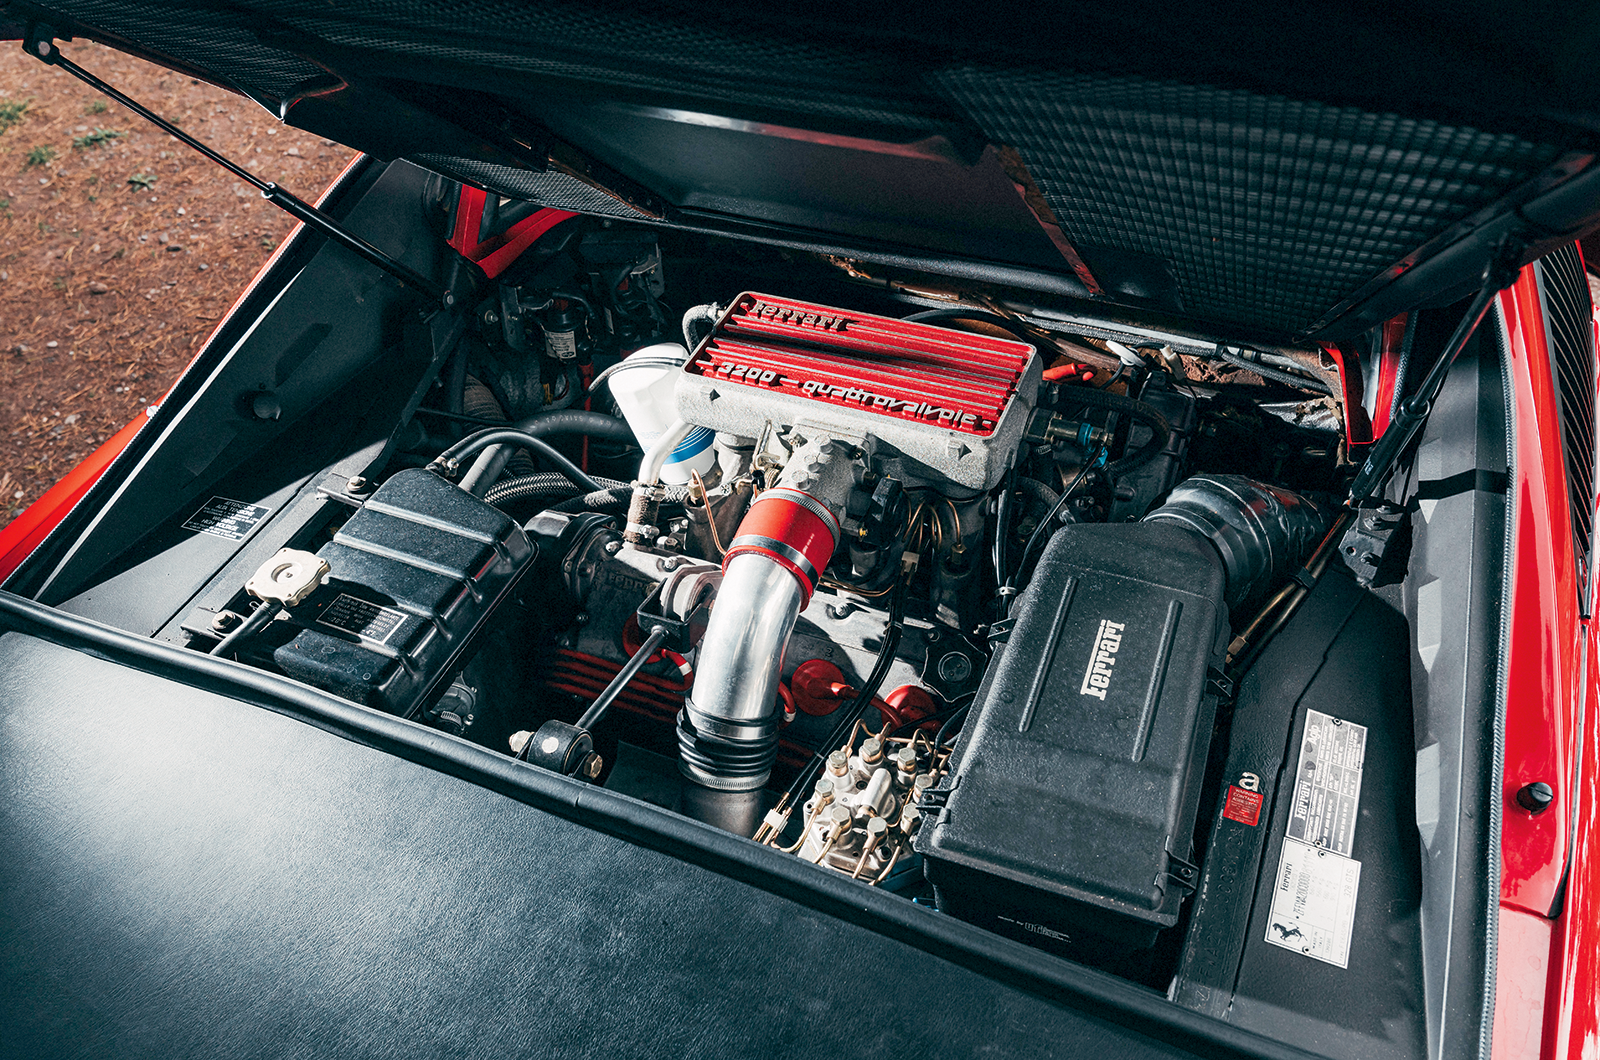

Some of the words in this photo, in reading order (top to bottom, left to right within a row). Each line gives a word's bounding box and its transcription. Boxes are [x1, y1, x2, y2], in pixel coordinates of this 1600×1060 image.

[752, 302, 844, 329] Ferrari
[719, 361, 777, 382] 3200
[803, 380, 977, 424] quattrovalvole
[1080, 620, 1125, 700] Ferrari
[1294, 780, 1310, 820] Ferrari
[1307, 724, 1319, 745] Agip
[1233, 792, 1259, 803] CONTAINS
[1235, 789, 1258, 798] WARNING
[1280, 862, 1293, 892] Ferrari
